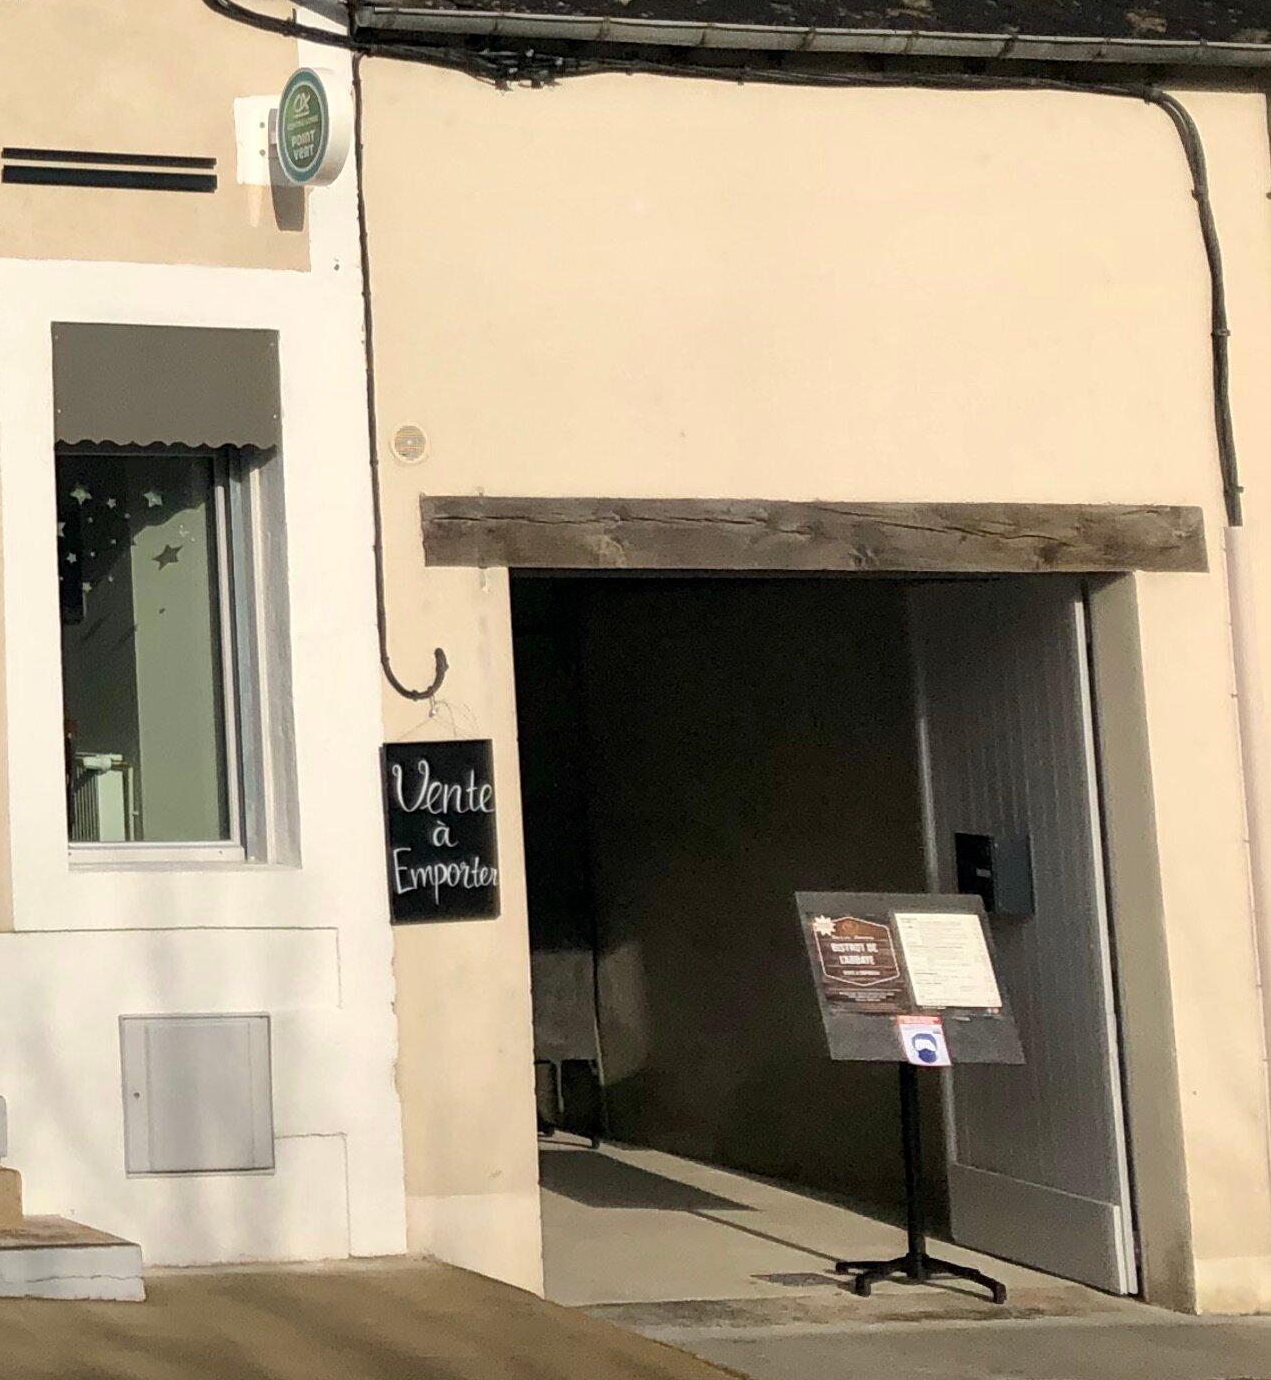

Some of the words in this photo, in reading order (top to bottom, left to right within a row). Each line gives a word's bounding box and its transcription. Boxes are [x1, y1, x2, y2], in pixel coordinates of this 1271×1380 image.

[391, 759, 495, 815] Vente
[431, 820, 458, 848] à
[392, 847, 499, 906] Emporter
